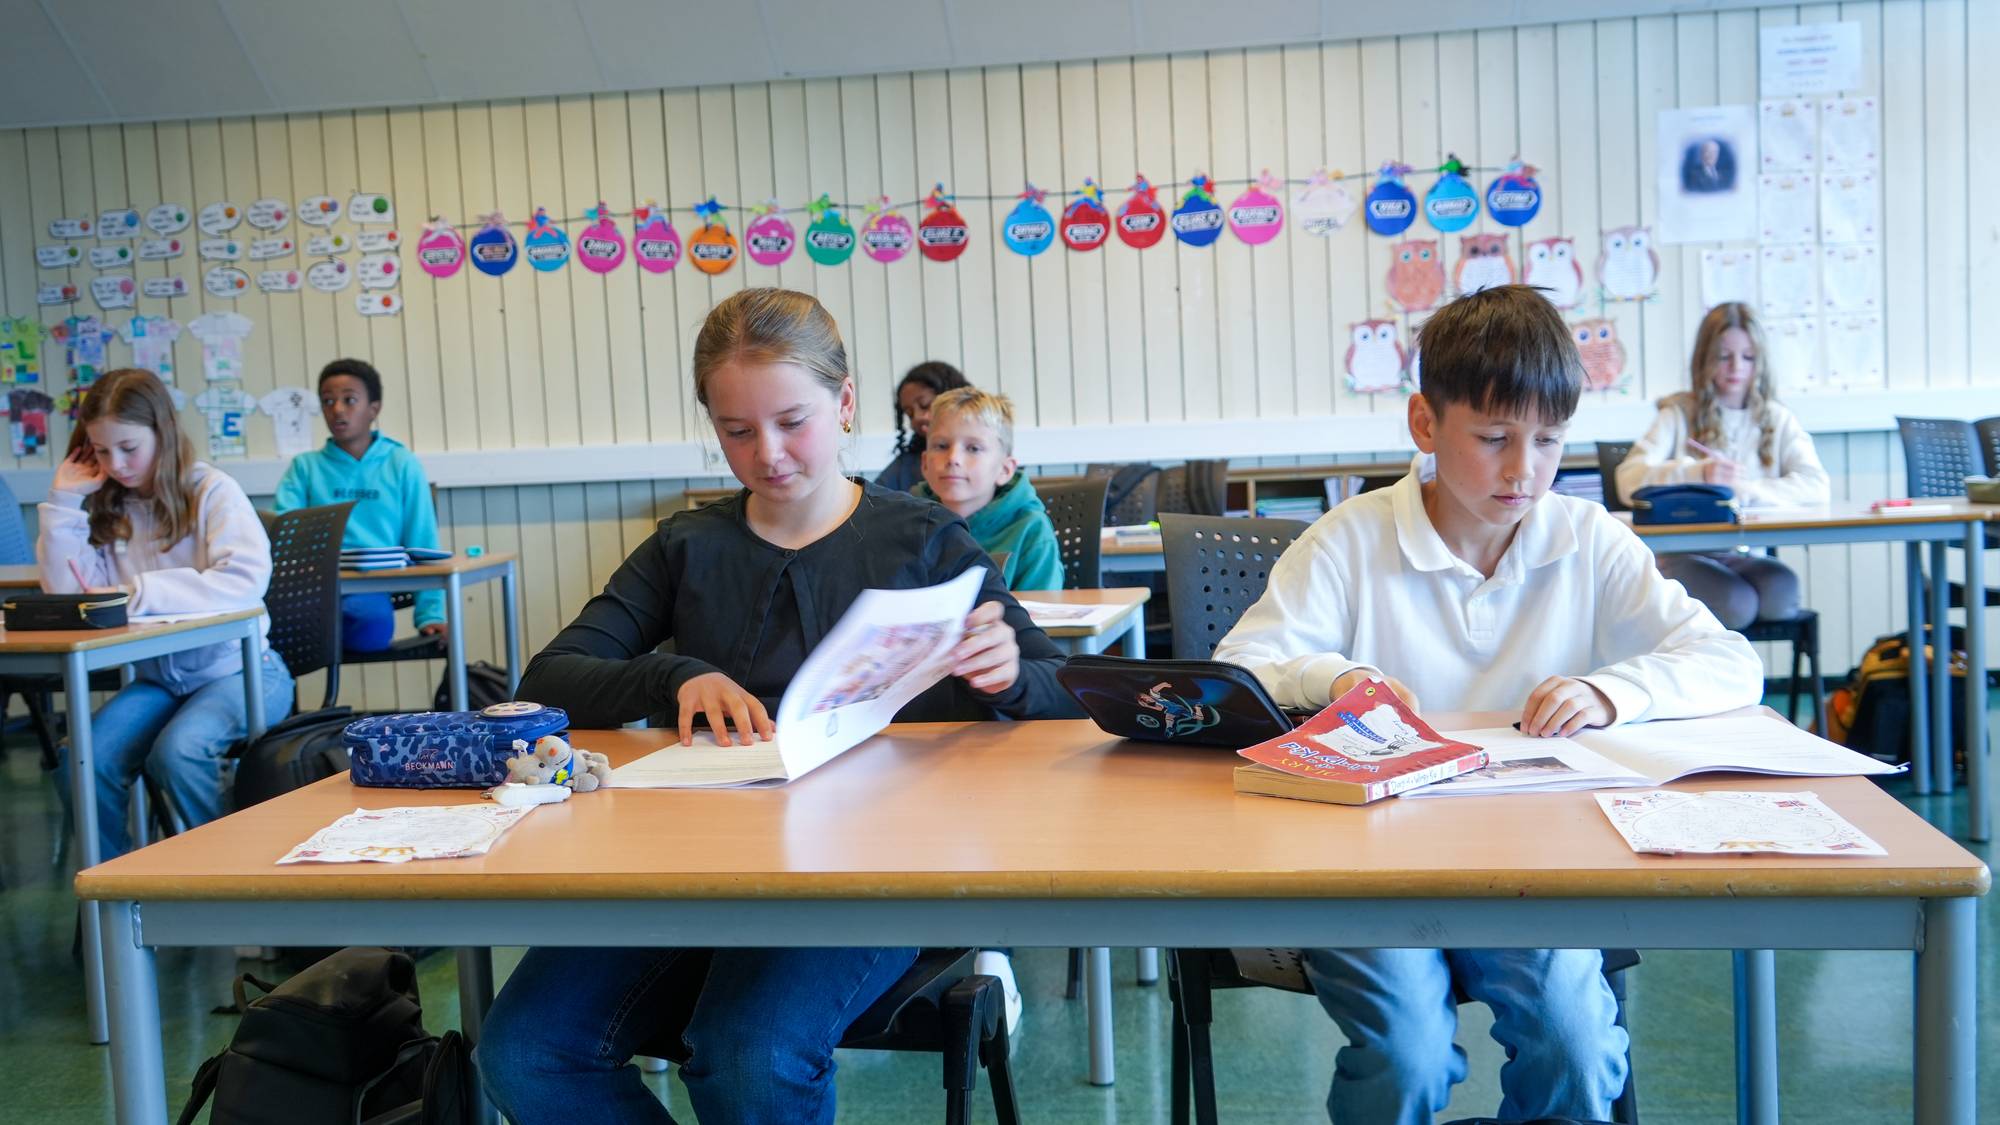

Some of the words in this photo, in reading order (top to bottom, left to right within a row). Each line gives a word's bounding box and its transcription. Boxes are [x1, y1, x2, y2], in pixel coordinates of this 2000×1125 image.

[224, 413, 241, 436] E
[1278, 742, 1319, 758] Kid
[404, 760, 454, 771] BECKMANN
